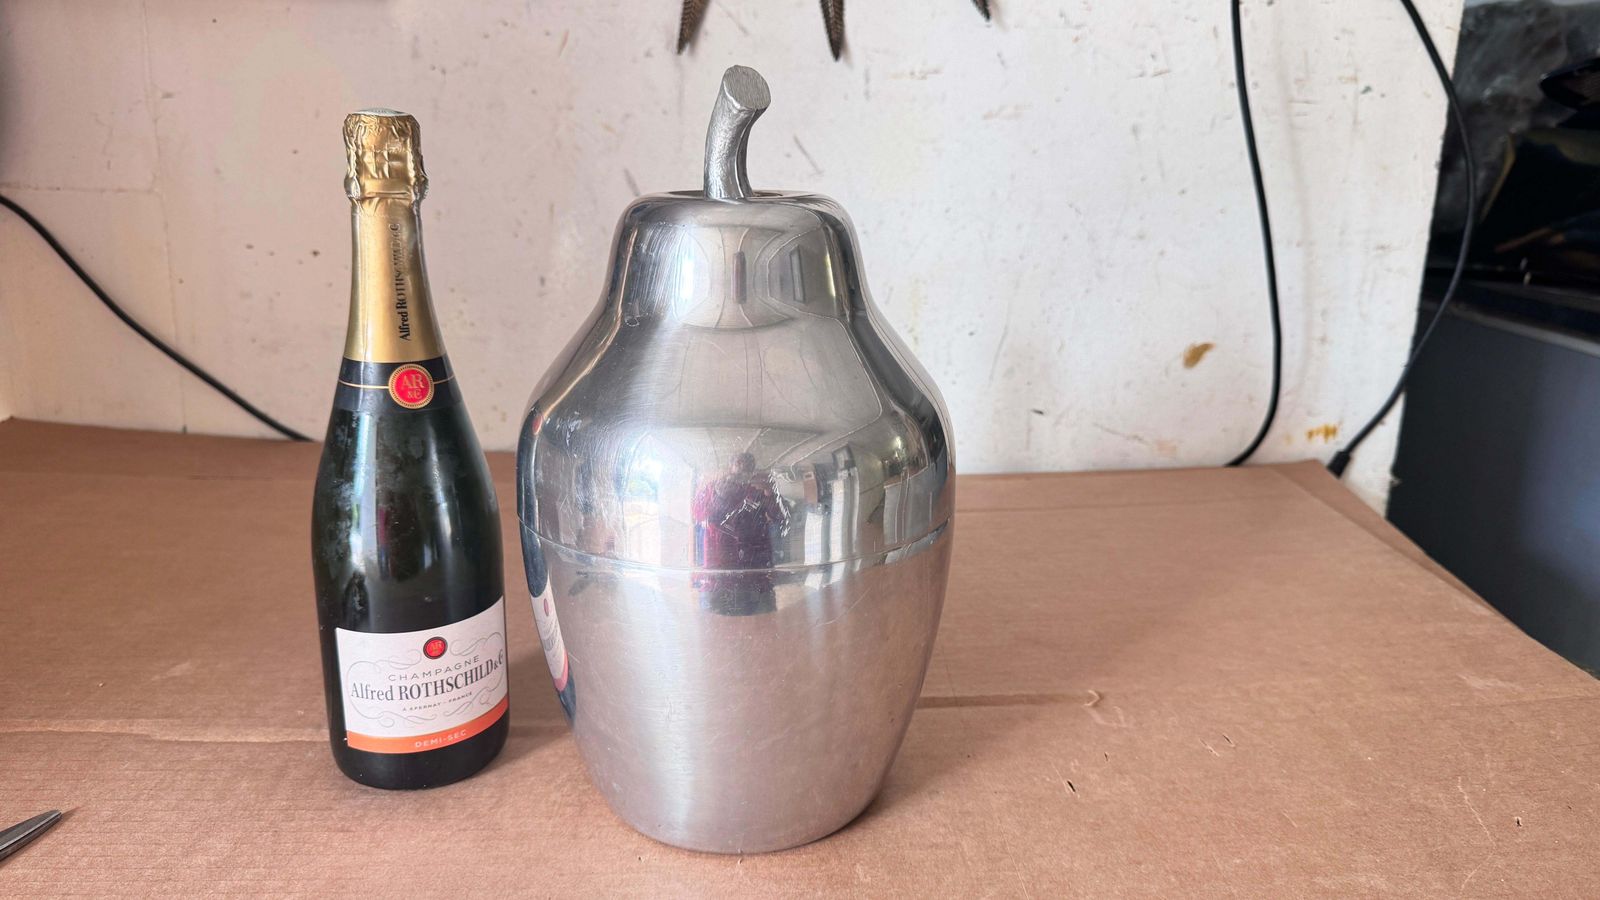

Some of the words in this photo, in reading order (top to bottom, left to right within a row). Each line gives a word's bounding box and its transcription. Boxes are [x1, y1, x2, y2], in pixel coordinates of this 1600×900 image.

[398, 311, 411, 341] Alfred
[401, 374, 425, 390] AR
[388, 654, 480, 682] CHAMPAGNE
[351, 682, 394, 701] Alfred
[415, 729, 467, 748] DEMI-SEC
